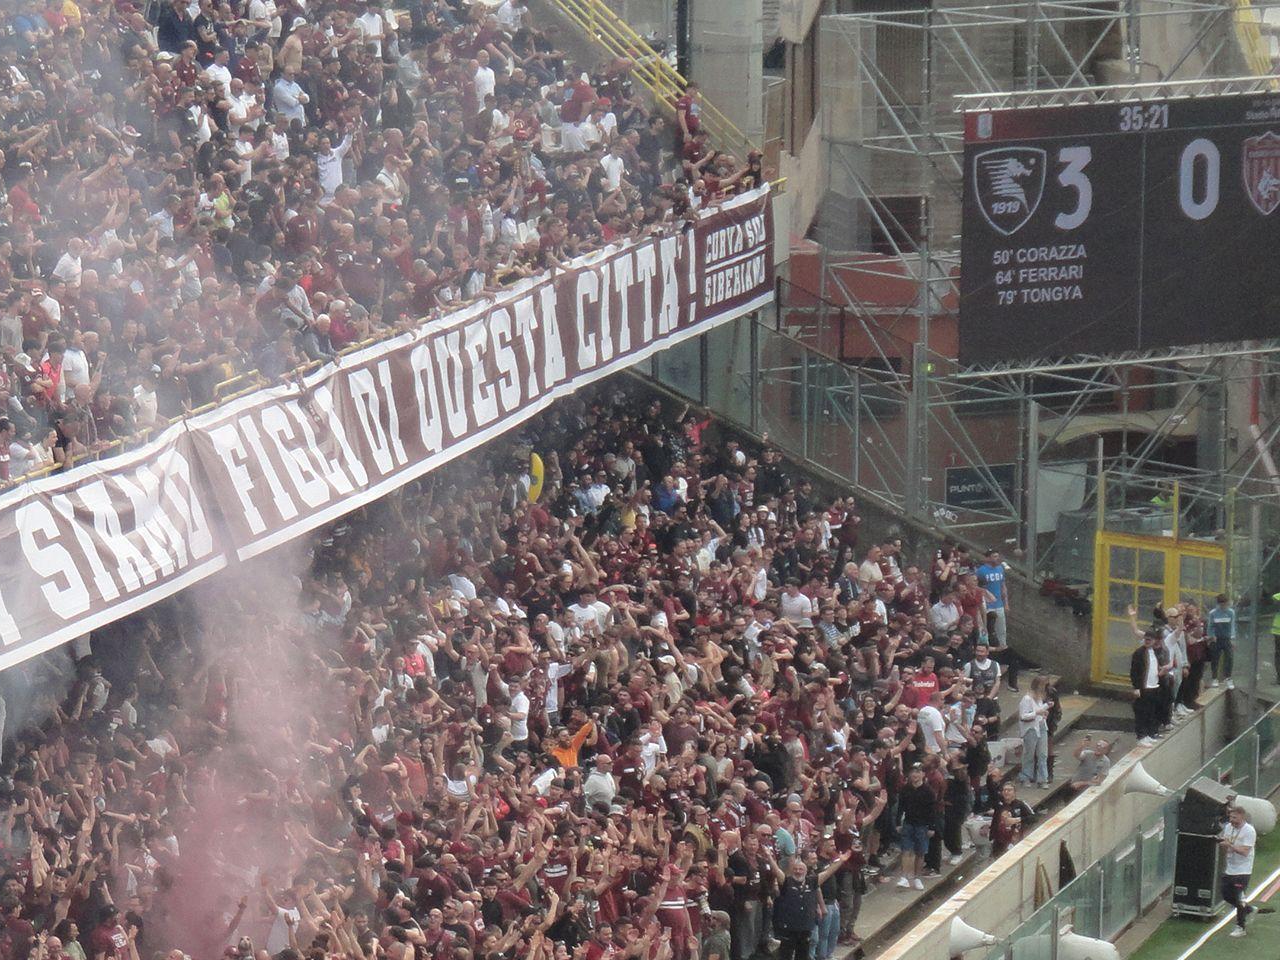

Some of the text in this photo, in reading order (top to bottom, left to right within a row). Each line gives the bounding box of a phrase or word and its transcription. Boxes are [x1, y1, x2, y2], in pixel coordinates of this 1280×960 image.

[1120, 104, 1169, 131] 35:21
[1055, 146, 1092, 230] 3
[1179, 138, 1220, 220] 0
[705, 214, 766, 264] CURVA SUD
[1016, 244, 1087, 263] CORAZZA
[1019, 265, 1083, 282] FERRARI
[1020, 285, 1083, 303] TONGYA
[15, 446, 213, 620] SIAMO
[208, 385, 369, 535] FIGLI
[347, 360, 408, 475] DI
[410, 285, 565, 454] QUESTA
